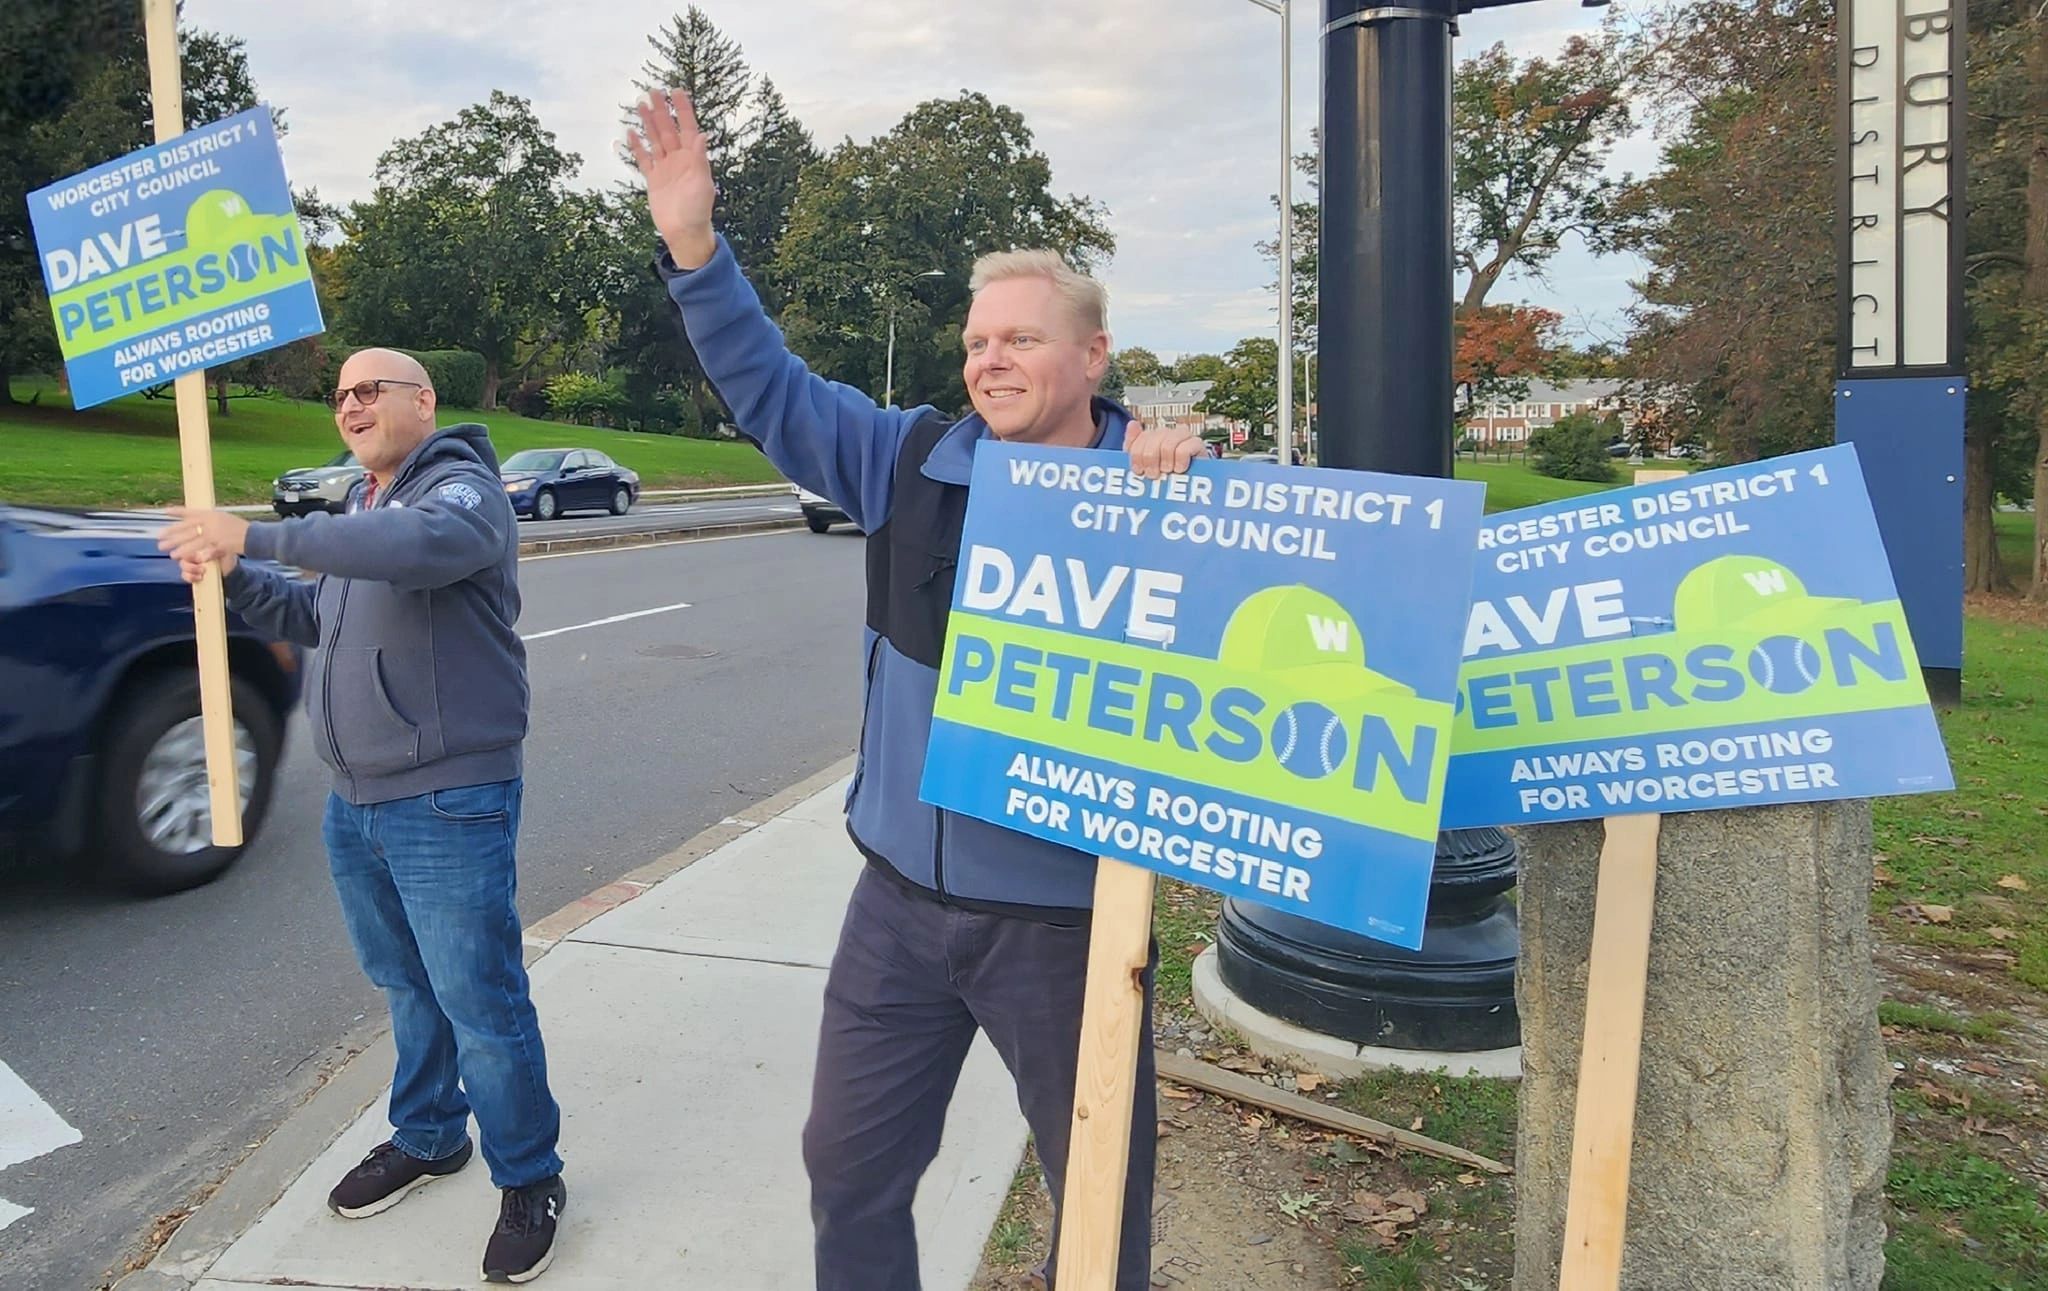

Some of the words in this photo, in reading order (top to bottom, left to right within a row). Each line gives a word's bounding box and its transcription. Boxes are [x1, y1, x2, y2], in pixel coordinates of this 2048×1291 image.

[1903, 9, 1952, 224] BURY
[48, 159, 155, 211] WORCESTER
[160, 124, 242, 168] DISTRICT
[248, 120, 257, 136] 1
[91, 190, 129, 217] CITY
[137, 159, 220, 198] COUNCIL
[1850, 46, 1879, 356] DISTRICT
[219, 195, 241, 217] W
[46, 214, 167, 291] DAVE
[59, 228, 299, 341] PETERSON
[115, 333, 181, 367] ALWAYS
[186, 304, 269, 340] ROOTING
[121, 365, 156, 387] FOR
[160, 325, 273, 372] WORCESTER
[1009, 459, 1212, 505] WORCESTER
[1225, 482, 1410, 524] DISTRICT
[1425, 499, 1444, 529] 1
[1071, 502, 1150, 535] CITY
[1161, 511, 1336, 560] COUNCIL
[1478, 504, 1622, 549] RCESTER
[1633, 468, 1796, 520] DISTRICT
[1808, 463, 1829, 486] 1
[1496, 541, 1567, 573] CITY
[1584, 511, 1750, 558] COUNCIL
[962, 544, 1183, 645] DAVE
[1463, 579, 1632, 656] AVE
[1743, 569, 1787, 597] W
[1307, 614, 1348, 652] W
[1455, 622, 1906, 729] ETERSON
[948, 634, 1437, 804] PETERSON
[1511, 747, 1646, 784] ALWAYS
[1657, 729, 1832, 768] ROOTING
[1007, 754, 1135, 810] ALWAYS
[1147, 788, 1323, 858] ROOTING
[1520, 783, 1590, 813] FOR
[1599, 762, 1839, 806] WORCESTER
[1007, 788, 1069, 834] FOR
[1081, 810, 1312, 902] WORCESTER
